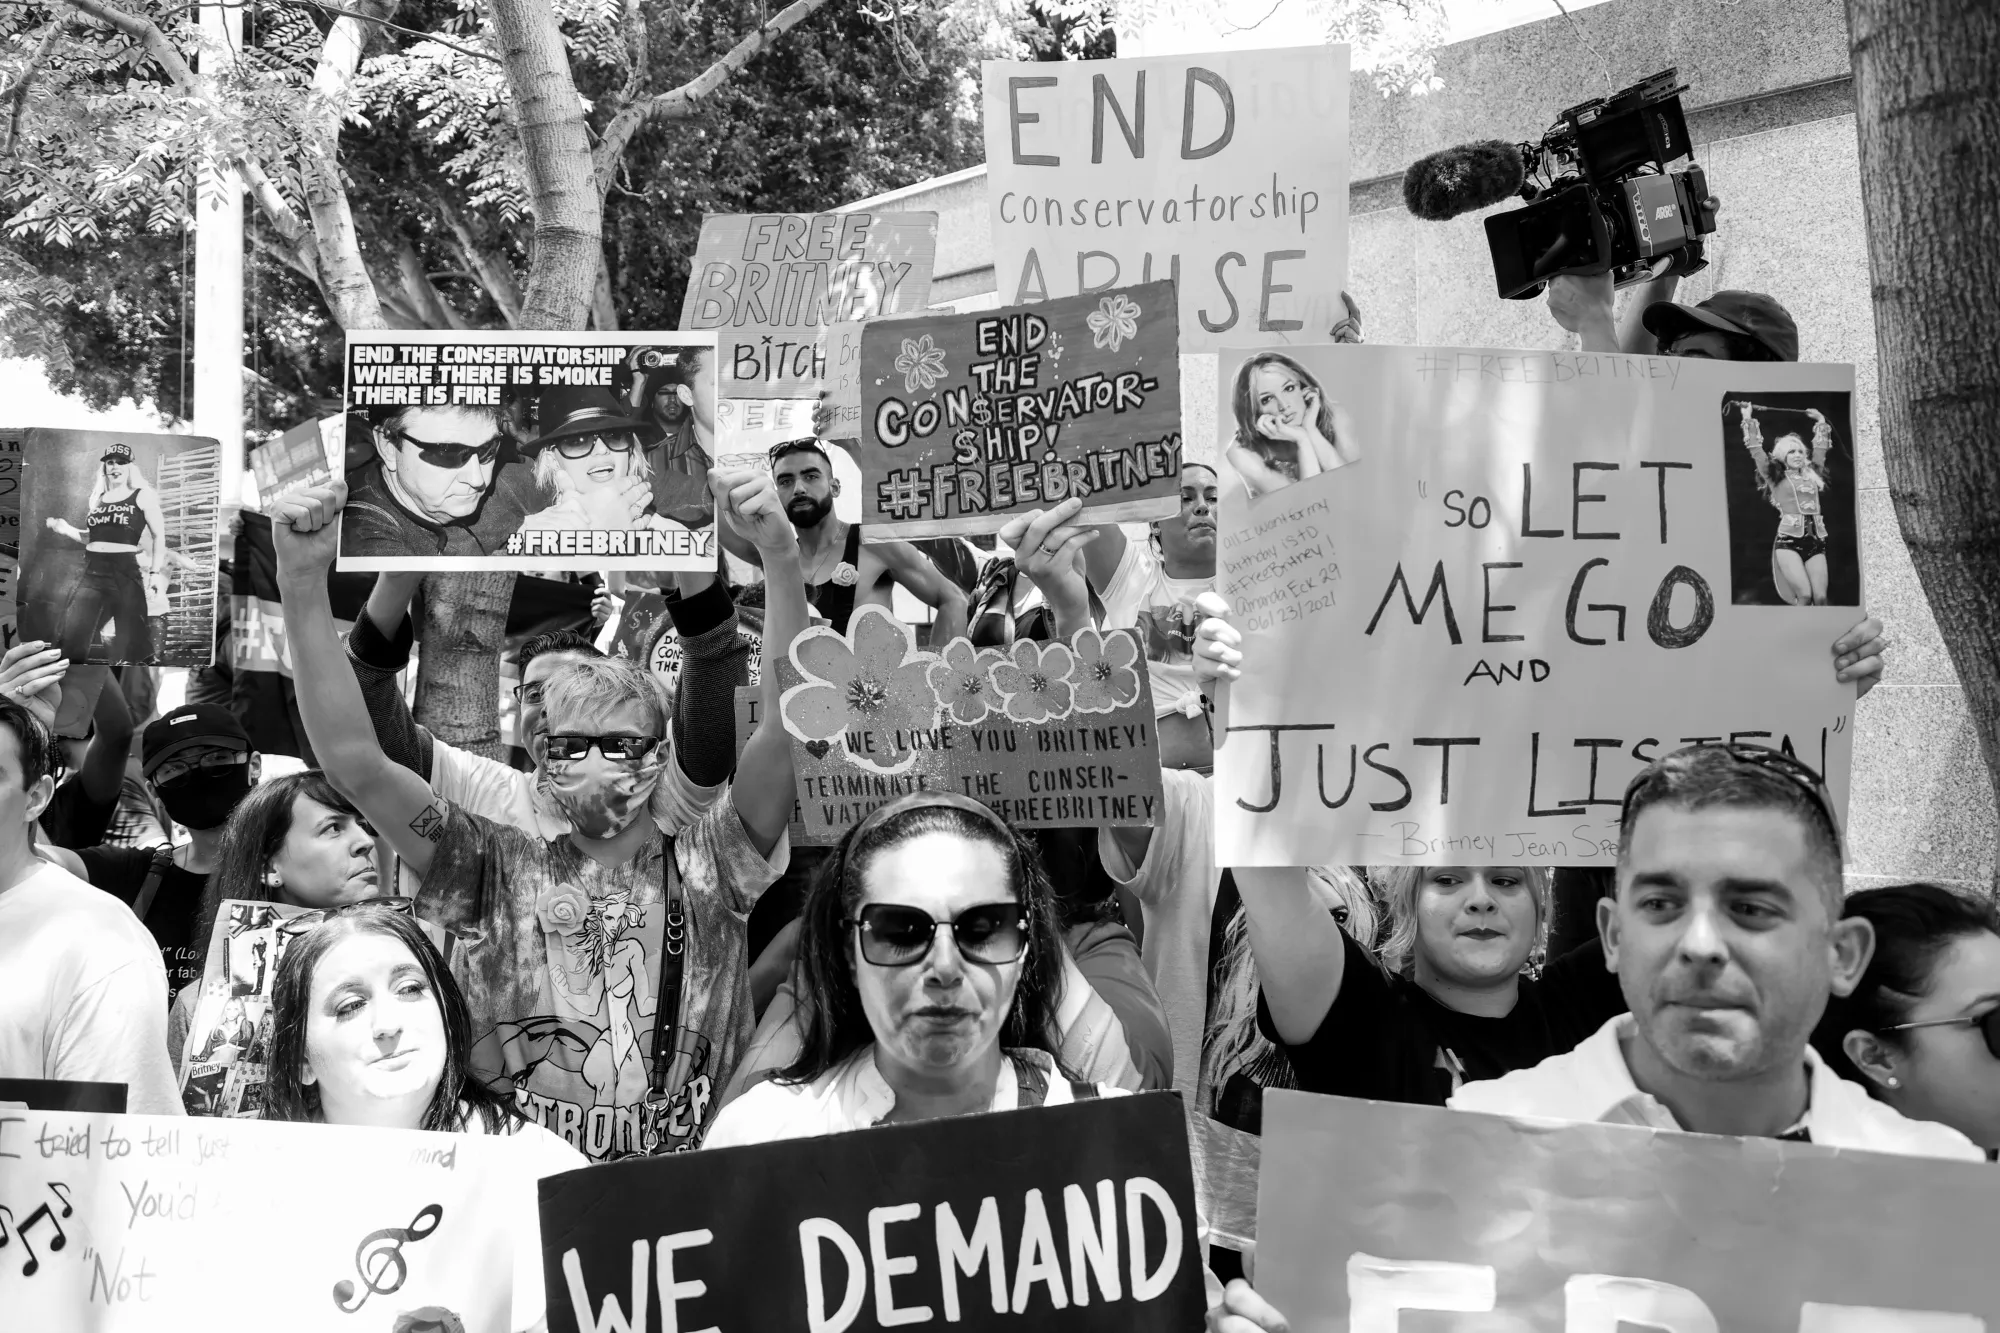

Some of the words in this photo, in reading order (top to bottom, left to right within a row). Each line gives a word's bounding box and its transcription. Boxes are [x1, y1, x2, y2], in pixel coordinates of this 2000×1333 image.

[1009, 67, 1235, 166] END
[1000, 173, 1318, 234] conservatorship
[742, 214, 871, 261] FREE
[691, 262, 912, 329] BRITNEY
[977, 313, 1047, 355] END
[353, 346, 394, 364] END
[400, 346, 437, 364] THE
[442, 346, 626, 365] CONSERVATORSHIP
[354, 365, 432, 384] WHERE
[438, 365, 506, 385] THERE
[512, 366, 532, 385] IS
[539, 366, 612, 386] SMOKE
[969, 353, 1040, 394] THE
[353, 386, 421, 405] THERE
[427, 386, 447, 405] IS
[452, 386, 500, 405] FIRE
[717, 402, 793, 430] REE
[106, 445, 130, 456] BOSS
[877, 433, 1182, 519] #FREEBRITNEY
[1521, 461, 1692, 544] LET
[507, 530, 712, 555] #FREEBRITNEY
[1365, 559, 1524, 645] ME
[1565, 558, 1715, 649] GO
[1464, 659, 1550, 686] AND
[845, 731, 875, 753] WE
[896, 727, 953, 751] LOVE
[971, 729, 1017, 752] YOU
[1037, 724, 1147, 752] BRITNEY!
[804, 775, 927, 799] TERMINATE
[962, 773, 1001, 796] THE
[1028, 766, 1129, 793] CONSER-
[1226, 724, 1480, 812] JUST
[1391, 822, 1494, 858] Britney
[1505, 833, 1567, 857] Jean
[1572, 824, 1619, 858] Spe
[35, 1121, 91, 1160] tried
[100, 1125, 131, 1160] to
[141, 1125, 180, 1157] tell
[561, 1228, 723, 1333] WE
[799, 1177, 1183, 1333] DEMAND
